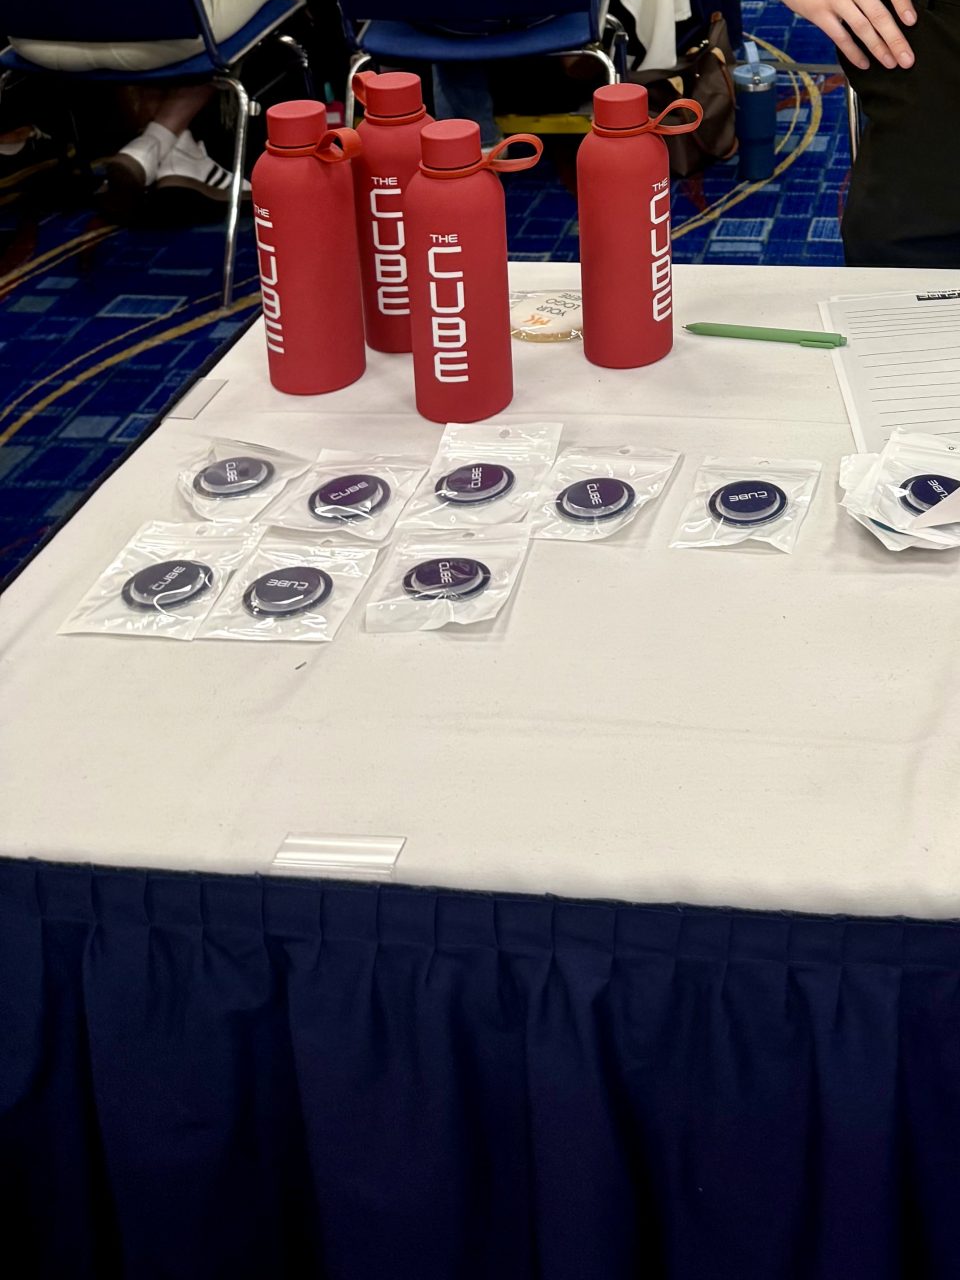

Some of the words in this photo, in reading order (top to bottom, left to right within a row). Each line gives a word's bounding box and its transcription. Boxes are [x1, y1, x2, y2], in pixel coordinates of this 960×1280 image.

[371, 176, 398, 186] THE
[652, 177, 669, 192] THE
[254, 203, 270, 218] THE
[429, 233, 458, 244] THE
[370, 188, 411, 316] CUBE
[650, 188, 672, 322] CUBE
[254, 216, 285, 354] CUBE
[535, 305, 567, 317] YOUR
[545, 298, 581, 311] LOGO
[427, 245, 469, 384] CUBE
[470, 467, 482, 488] CUBE
[329, 480, 369, 501] CUBE
[586, 483, 603, 505] CUBE
[728, 489, 768, 502] CUBE
[151, 566, 186, 591] CUBE
[265, 578, 309, 590] CUBE
